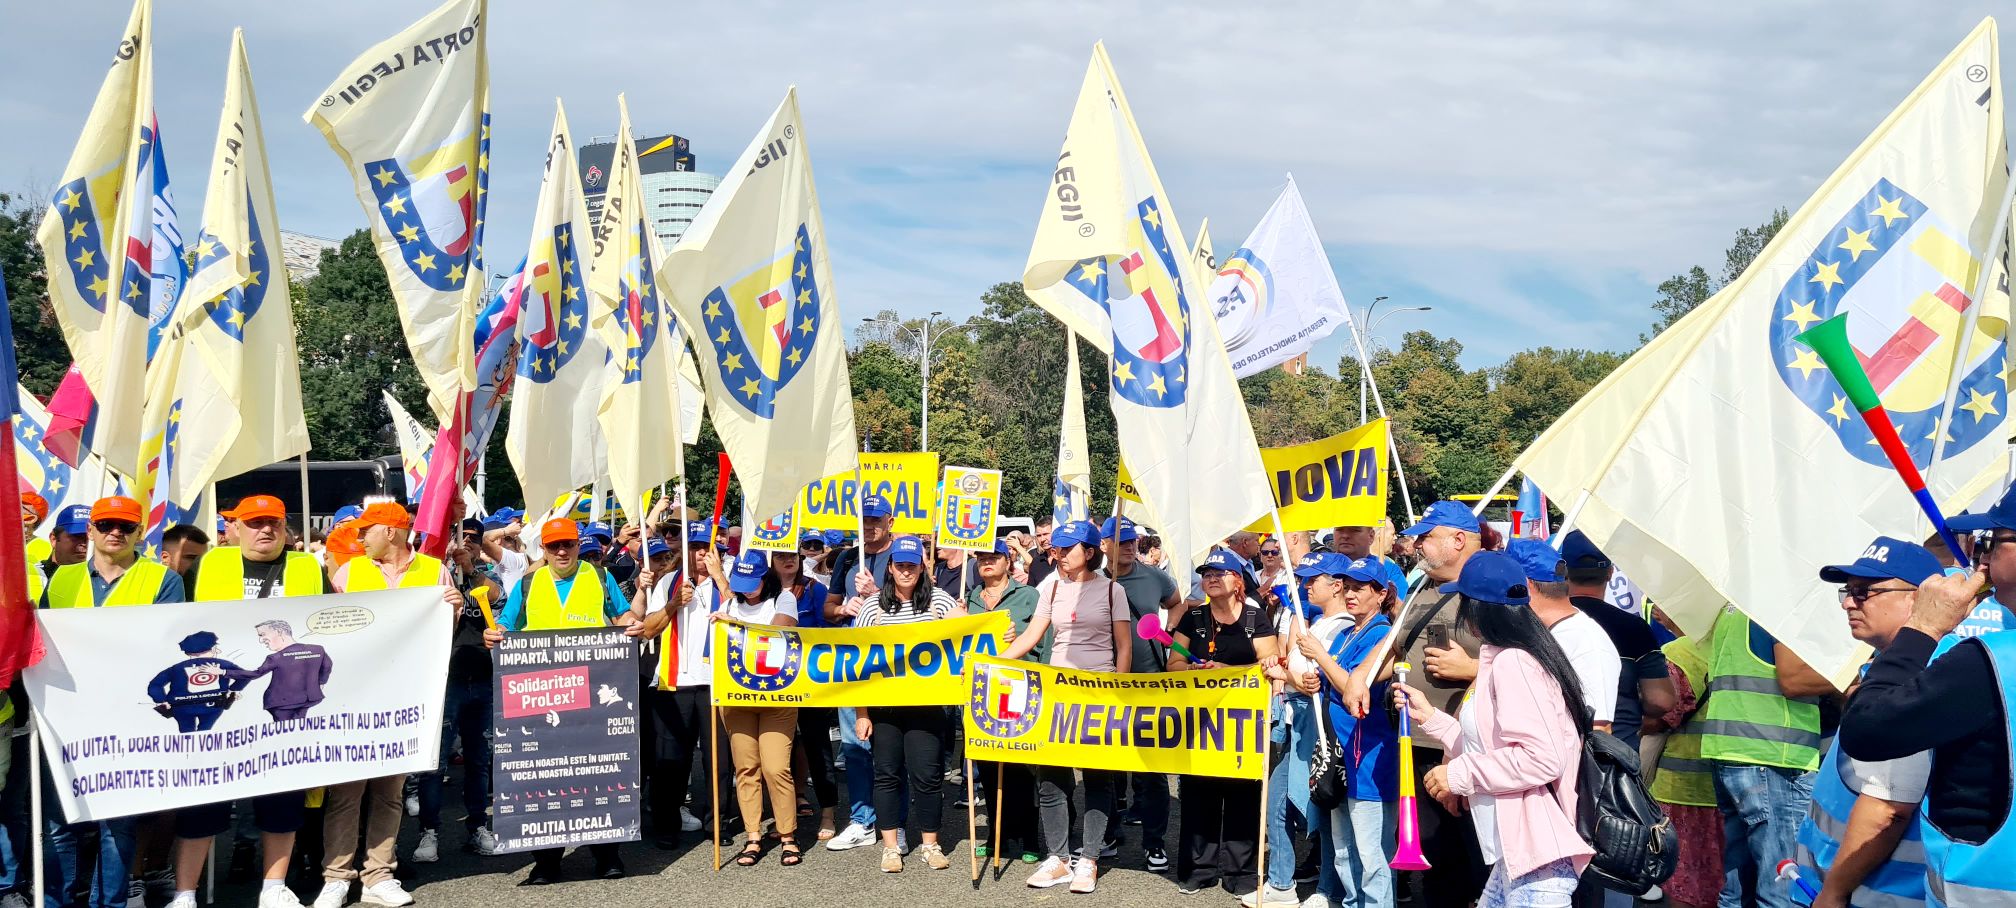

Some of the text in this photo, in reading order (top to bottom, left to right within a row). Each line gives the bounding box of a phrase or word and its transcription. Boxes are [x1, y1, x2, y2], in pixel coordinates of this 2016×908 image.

[1267, 447, 1378, 508] IOVA
[529, 636, 551, 649] UNII
[554, 632, 604, 647] ÎNCEARCĂ
[605, 631, 618, 645] SĂ
[619, 634, 632, 645] NE
[554, 650, 574, 663] NOI
[576, 649, 592, 662] NE
[806, 633, 998, 684] CRAIOVA
[508, 674, 584, 695] Solidaritate
[1055, 672, 1260, 693] Administrația Locală
[522, 689, 575, 710] ProLex!
[727, 692, 767, 703] FORȚA
[62, 741, 79, 764] NU
[128, 735, 160, 753] DOAR
[163, 733, 195, 759] UNIȚI
[199, 732, 223, 752] VOM
[226, 724, 258, 749] REUȘI
[261, 718, 295, 739] ACOLO
[299, 715, 326, 731] UNDE
[329, 713, 354, 736] ALȚII
[357, 712, 370, 730] AU
[373, 711, 391, 729] DAT
[394, 705, 420, 728] GREȘ
[969, 738, 1004, 751] FORȚA
[1048, 701, 1265, 769] MEHEDINȚI
[72, 769, 154, 797] SOLIDARITATE
[158, 769, 169, 795] ȘI
[172, 766, 219, 788] UNITATE
[222, 761, 234, 783] ÎN
[238, 751, 278, 778] POLIȚIA
[281, 741, 321, 766] LOCALĂ
[324, 745, 342, 762] DIN
[345, 740, 377, 762] TOATĂ
[379, 741, 405, 767] ȚARA
[501, 761, 535, 771] PUTEREA
[536, 755, 569, 768] NOASTRĂ
[570, 756, 587, 765] ESTE
[598, 752, 630, 764] UNITATE.
[511, 771, 537, 782] VOCEA
[538, 767, 574, 779] NOASTRĂ
[521, 813, 613, 836] POLIȚIA LOCALĂ
[509, 839, 521, 849] NU
[522, 838, 533, 847] SE
[534, 834, 569, 846] REDUCE,
[571, 833, 582, 843] SE
